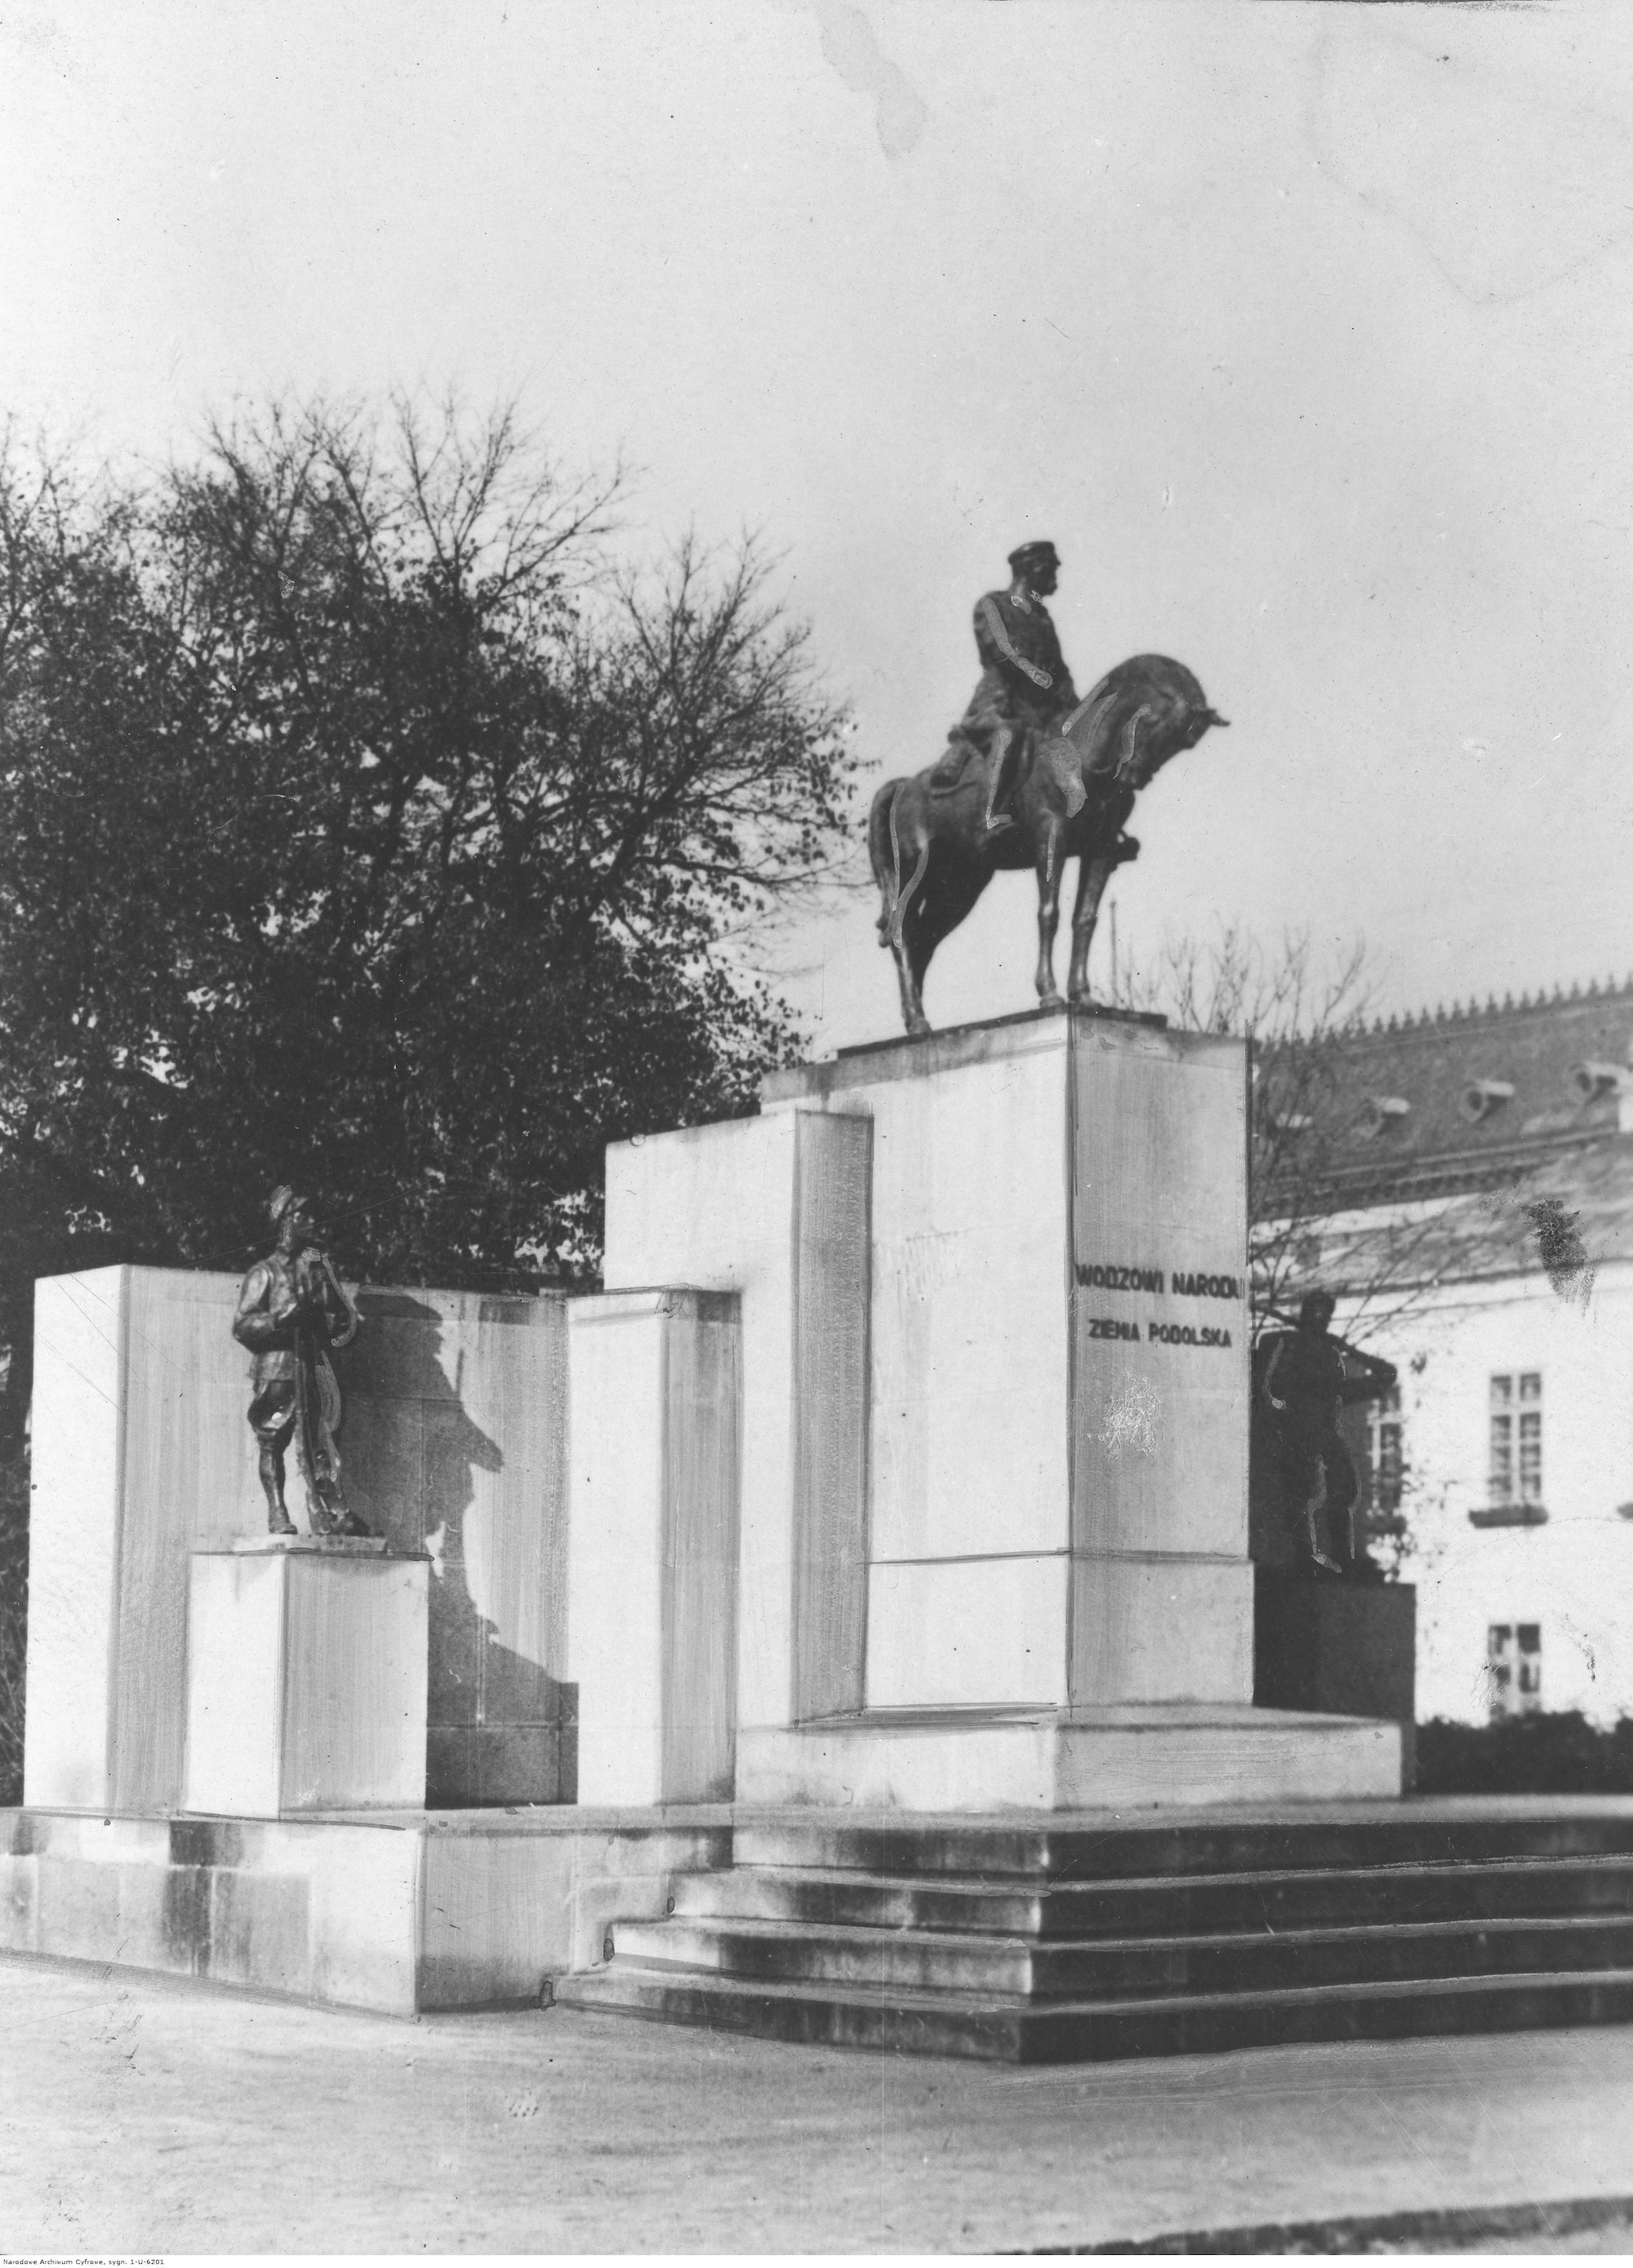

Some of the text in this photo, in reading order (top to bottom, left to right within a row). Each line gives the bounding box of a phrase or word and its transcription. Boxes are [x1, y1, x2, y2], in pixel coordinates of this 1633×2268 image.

[1075, 1264, 1164, 1294] WODZOWI
[1088, 1318, 1232, 1348] ZIEMIA PODOLSKA
